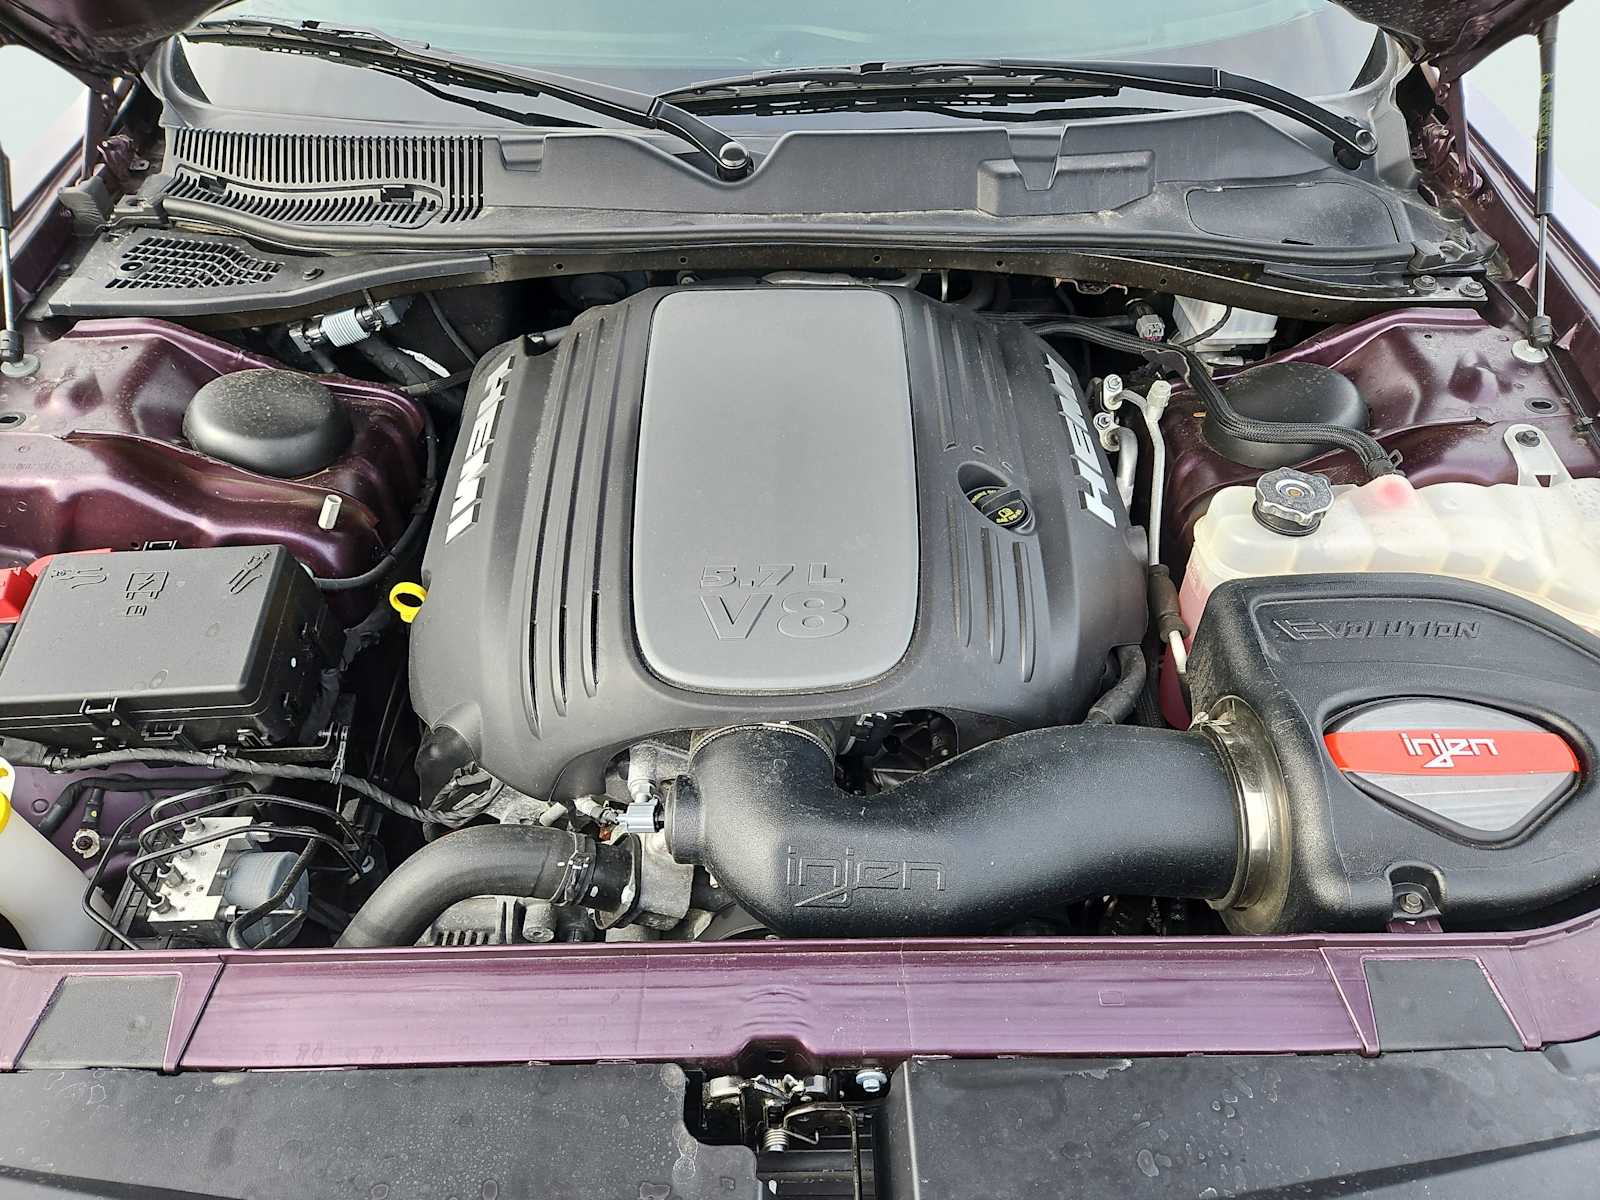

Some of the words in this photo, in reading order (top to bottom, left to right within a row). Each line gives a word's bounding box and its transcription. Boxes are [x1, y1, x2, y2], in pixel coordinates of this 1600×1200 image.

[445, 354, 514, 544] HEMI
[1045, 353, 1117, 528] HEMI
[700, 591, 849, 641] V8
[1273, 619, 1481, 641] EVOLUTION
[1399, 731, 1499, 769] injen
[787, 845, 947, 909] injen
